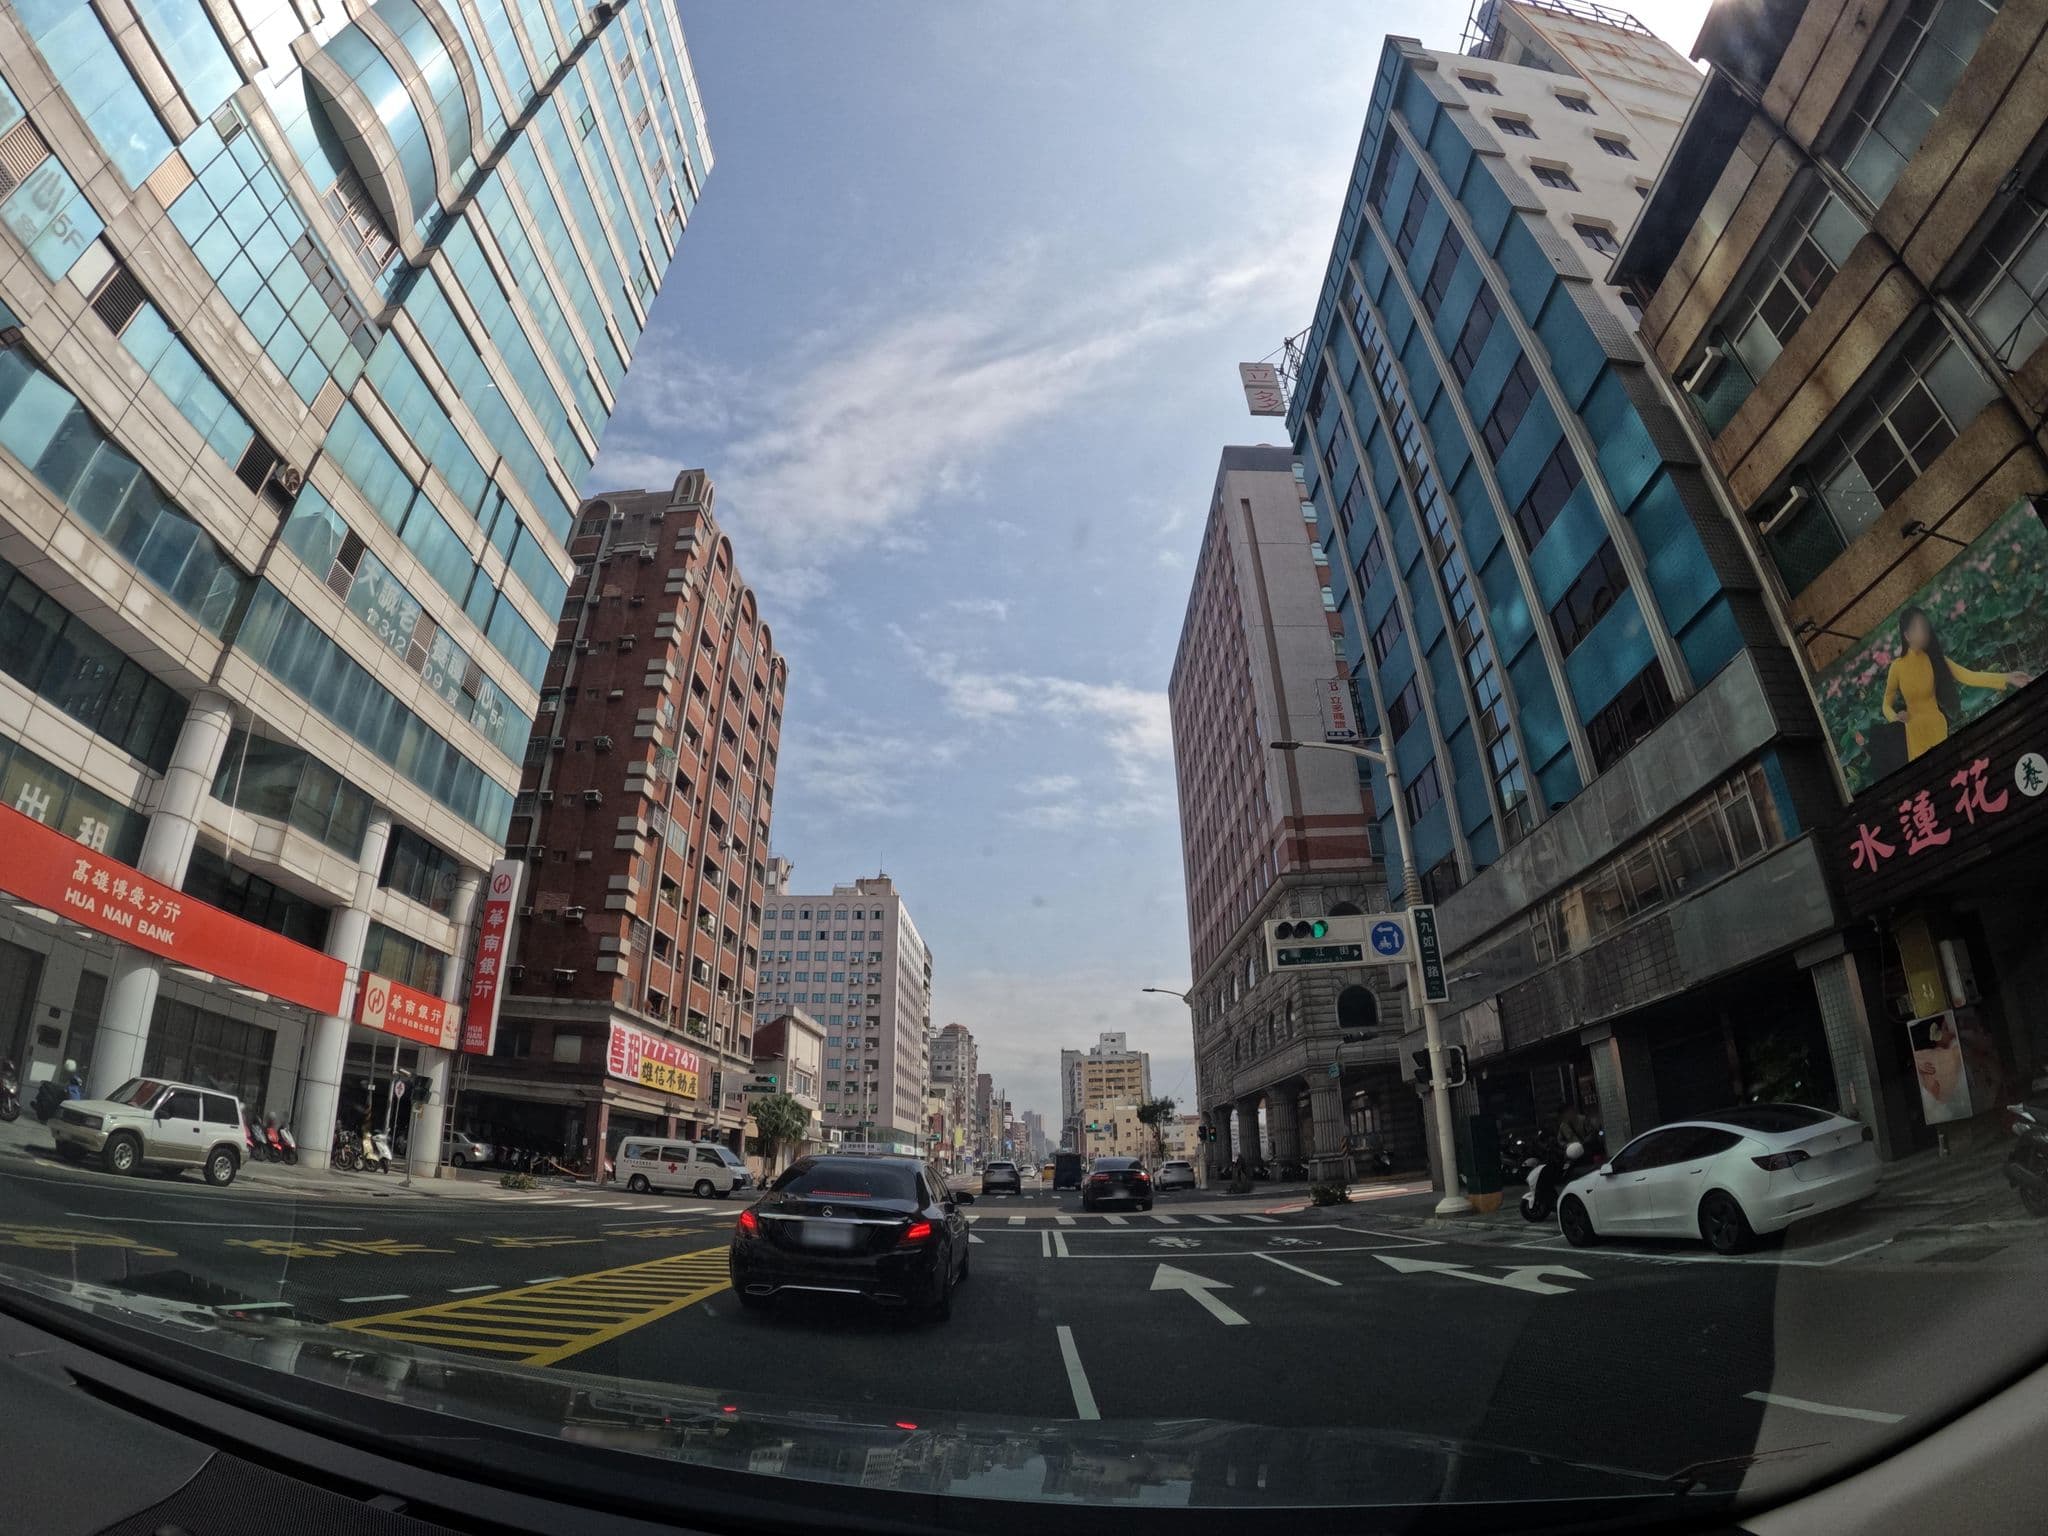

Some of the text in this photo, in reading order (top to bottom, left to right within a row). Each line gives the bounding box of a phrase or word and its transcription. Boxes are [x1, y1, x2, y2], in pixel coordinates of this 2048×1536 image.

[52, 212, 86, 250] 5F
[14, 782, 110, 853] 出租
[1850, 757, 2009, 873] 水蓮花
[64, 887, 175, 945] HUA NAN BANK
[71, 858, 182, 923] 高雄博愛分行
[473, 907, 505, 999] 華南銀行
[1419, 921, 1440, 977] 九如二路
[389, 993, 443, 1025] 華南銀行
[609, 1024, 641, 1078] 售租
[641, 1061, 697, 1096] 雄信不動產
